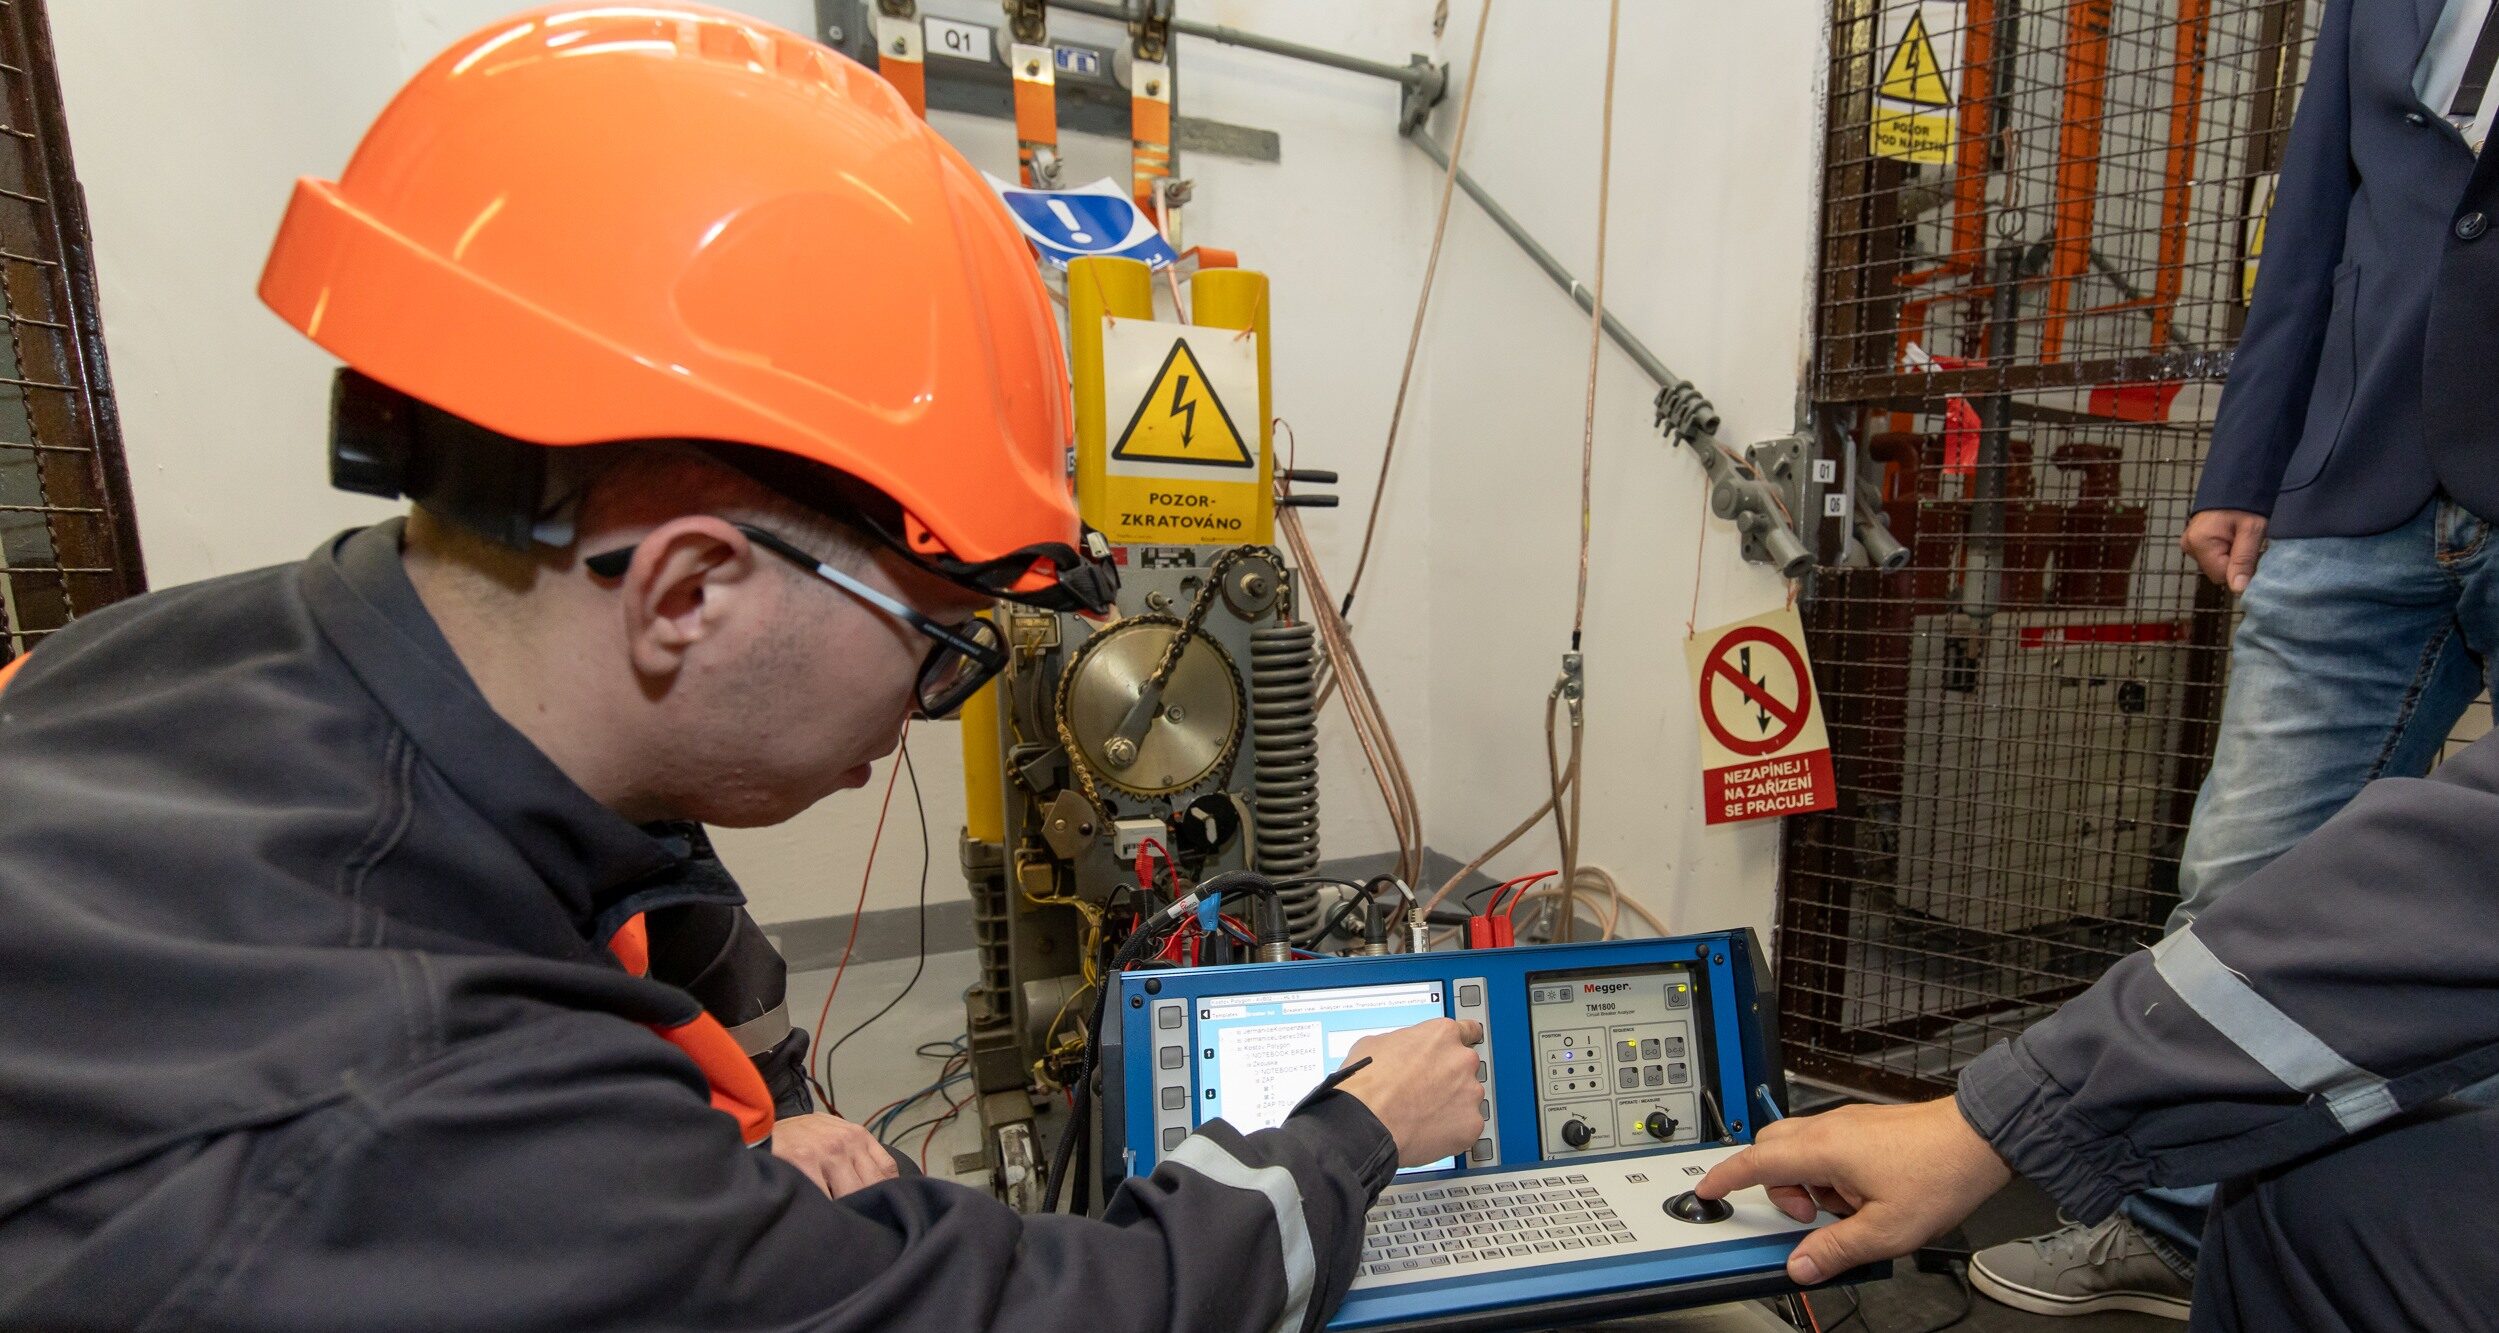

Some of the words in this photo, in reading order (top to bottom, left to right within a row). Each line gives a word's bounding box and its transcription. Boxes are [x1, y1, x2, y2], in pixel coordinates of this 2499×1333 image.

[945, 29, 971, 52] Q1
[1820, 464, 1830, 479] Q1
[1149, 492, 1216, 507] POZOR-
[1121, 513, 1242, 530] ZKRATOVÁNO
[1724, 760, 1801, 785] NEZAPÍNEJ
[1804, 758, 1810, 771] !
[1724, 788, 1745, 801] NA
[1747, 773, 1813, 798] ZAŘÍZENÍ
[1725, 803, 1743, 817] SE
[1747, 792, 1815, 814] PRACUJE
[1586, 1003, 1616, 1011] TM1800
[1252, 1050, 1289, 1058] NOTEBOOK
[1261, 1066, 1298, 1075] NOTEBOOK
